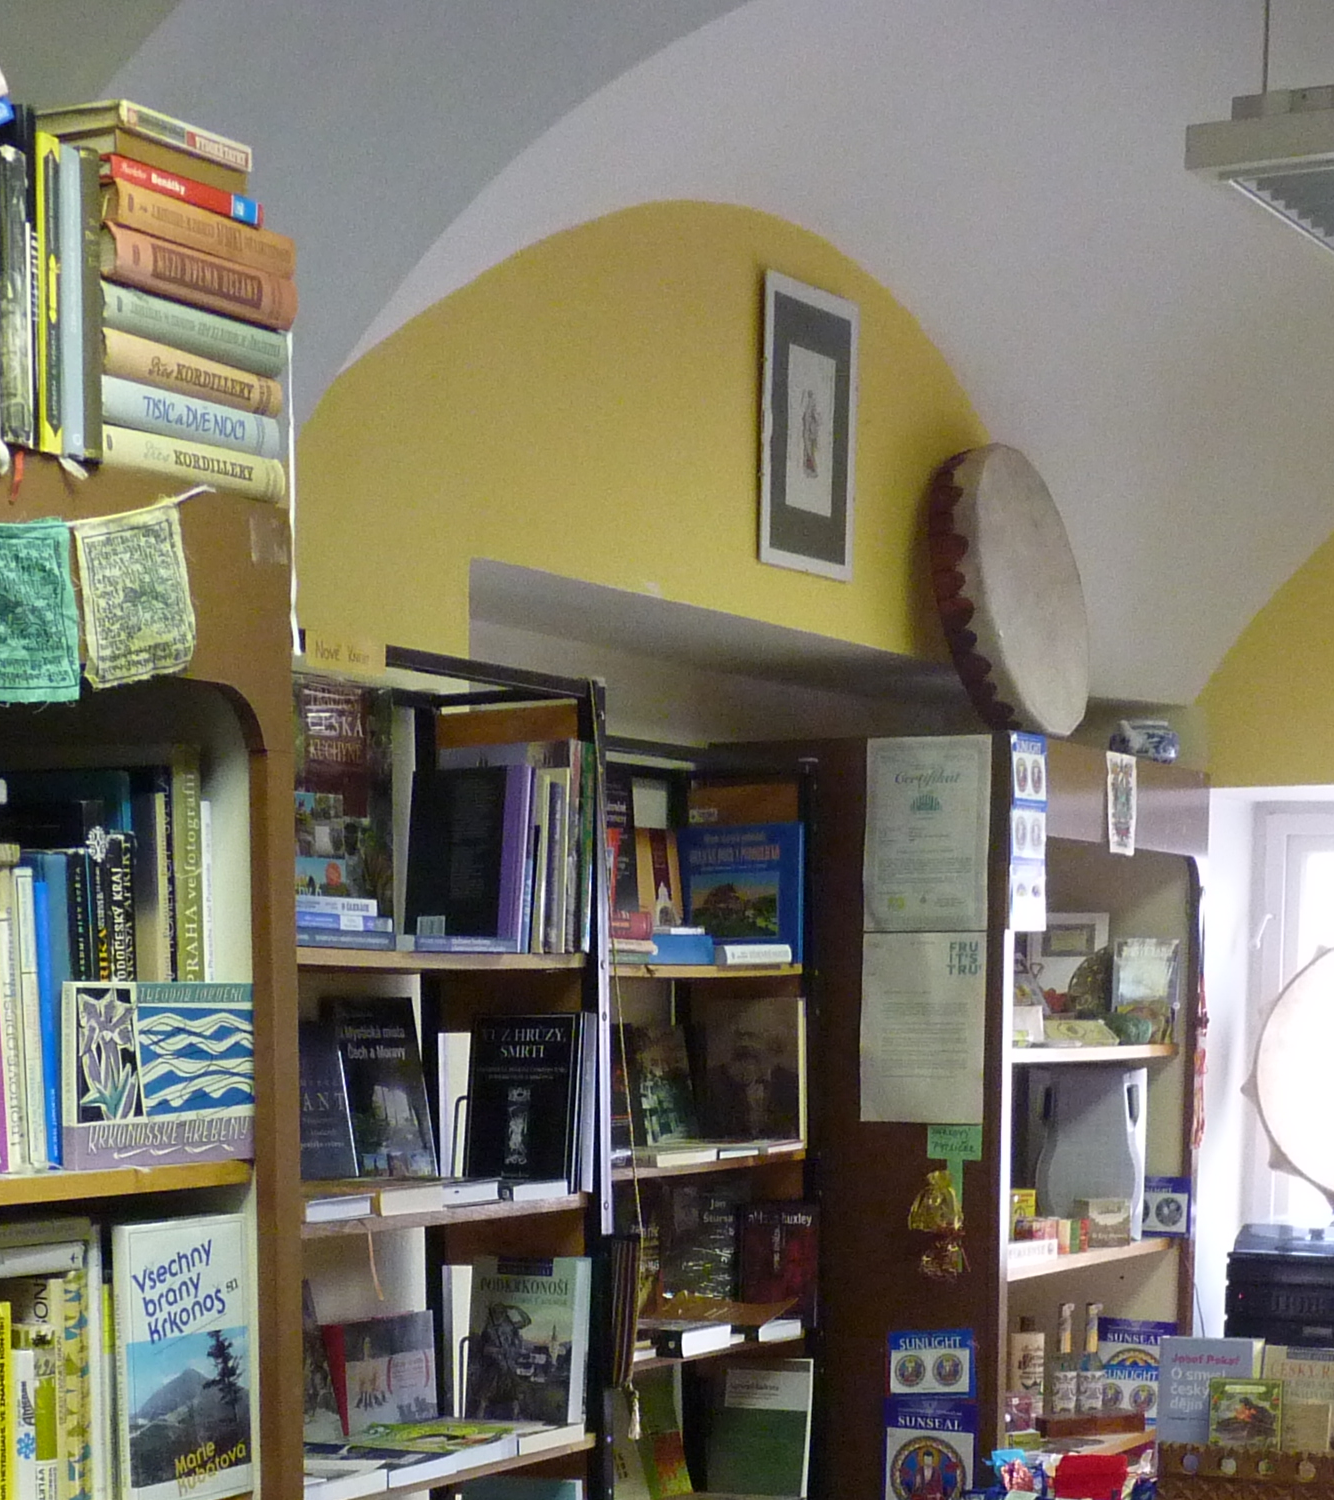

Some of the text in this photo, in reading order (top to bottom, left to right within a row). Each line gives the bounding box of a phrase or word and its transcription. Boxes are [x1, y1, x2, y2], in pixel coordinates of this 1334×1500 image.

[174, 361, 255, 401] KORDILLERY
[142, 395, 176, 423] TISÍC
[185, 404, 212, 435] DVĚ
[212, 411, 246, 442] NOCI
[173, 448, 255, 482] KORDILLERY
[949, 941, 979, 953] FRU
[131, 1238, 213, 1296] Všechny
[149, 1284, 227, 1345] Krkonoš
[898, 1334, 962, 1351] SUNLIGHT
[1171, 1353, 1203, 1365] Josef
[1169, 1396, 1204, 1414] dějin
[897, 1415, 963, 1431] SUNSEAL
[174, 1440, 216, 1479] Marie
